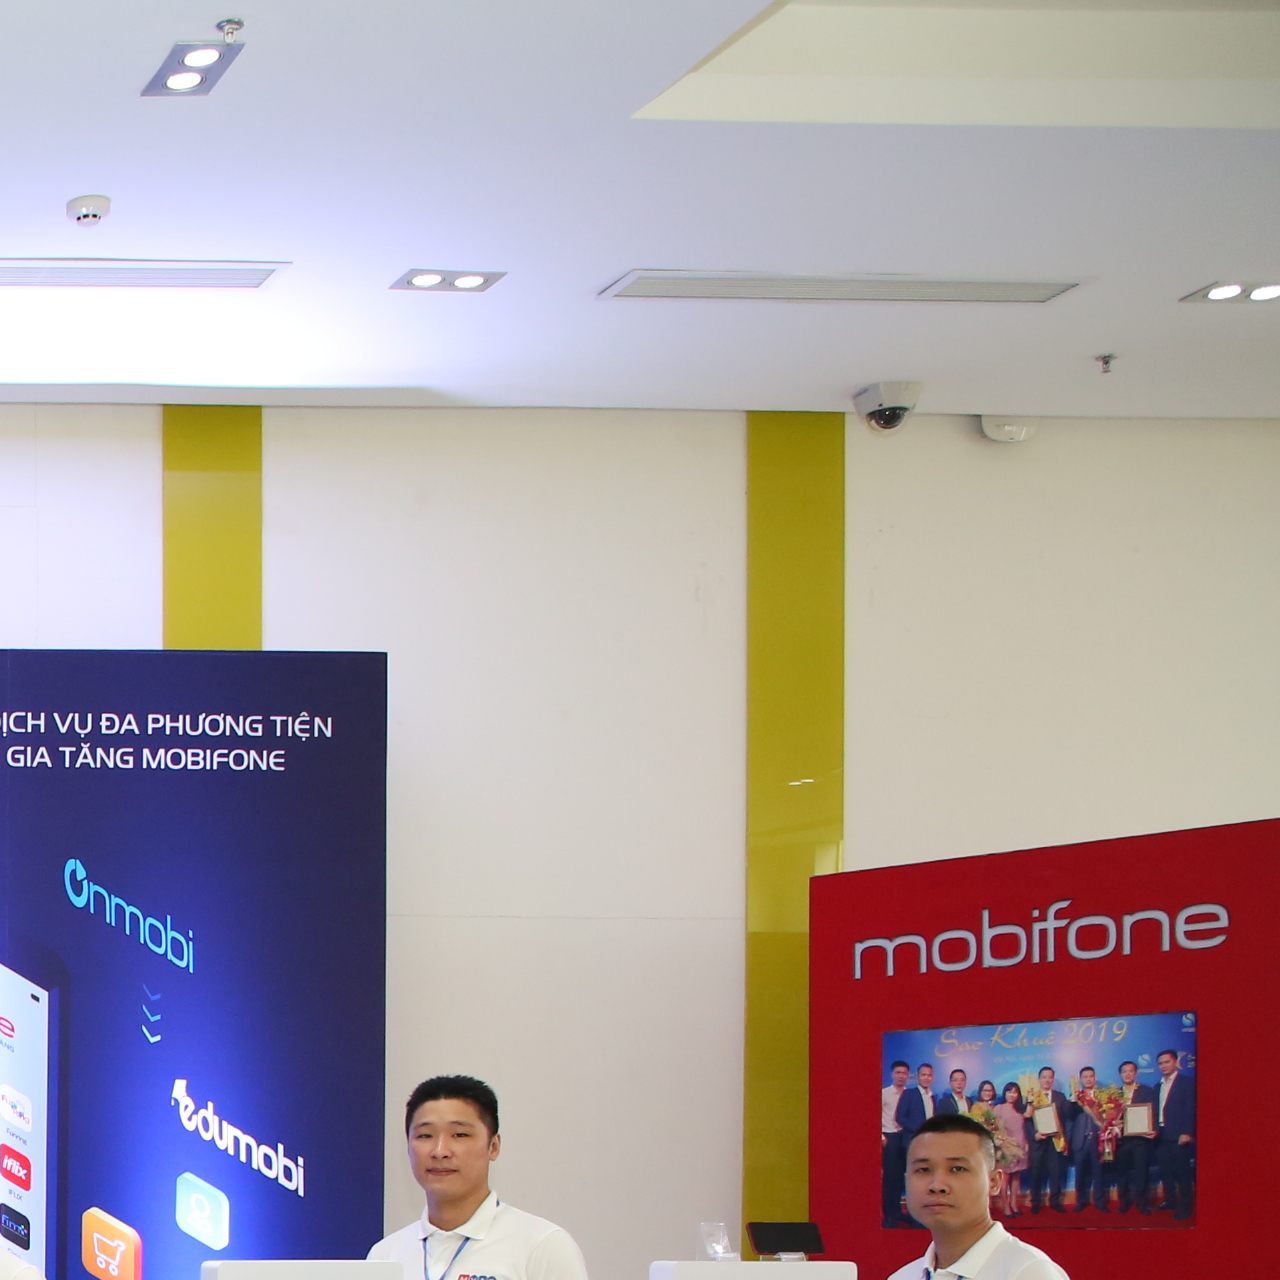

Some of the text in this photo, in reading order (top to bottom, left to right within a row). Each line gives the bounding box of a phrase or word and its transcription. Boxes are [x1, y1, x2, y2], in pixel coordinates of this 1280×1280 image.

[54, 713, 93, 739] VỤ
[100, 713, 139, 735] ĐA
[148, 712, 263, 737] PHƯƠNG
[271, 711, 333, 741] TIỆN
[7, 747, 52, 768] GIA
[60, 742, 134, 769] TĂNG
[142, 749, 285, 771] MOBIFONE
[64, 858, 194, 974] Onmobi
[853, 900, 1230, 980] mobifone
[935, 1020, 1128, 1058] Sao Khuê 2019
[177, 1090, 305, 1197] edumobi
[2, 1155, 28, 1180] iflix
